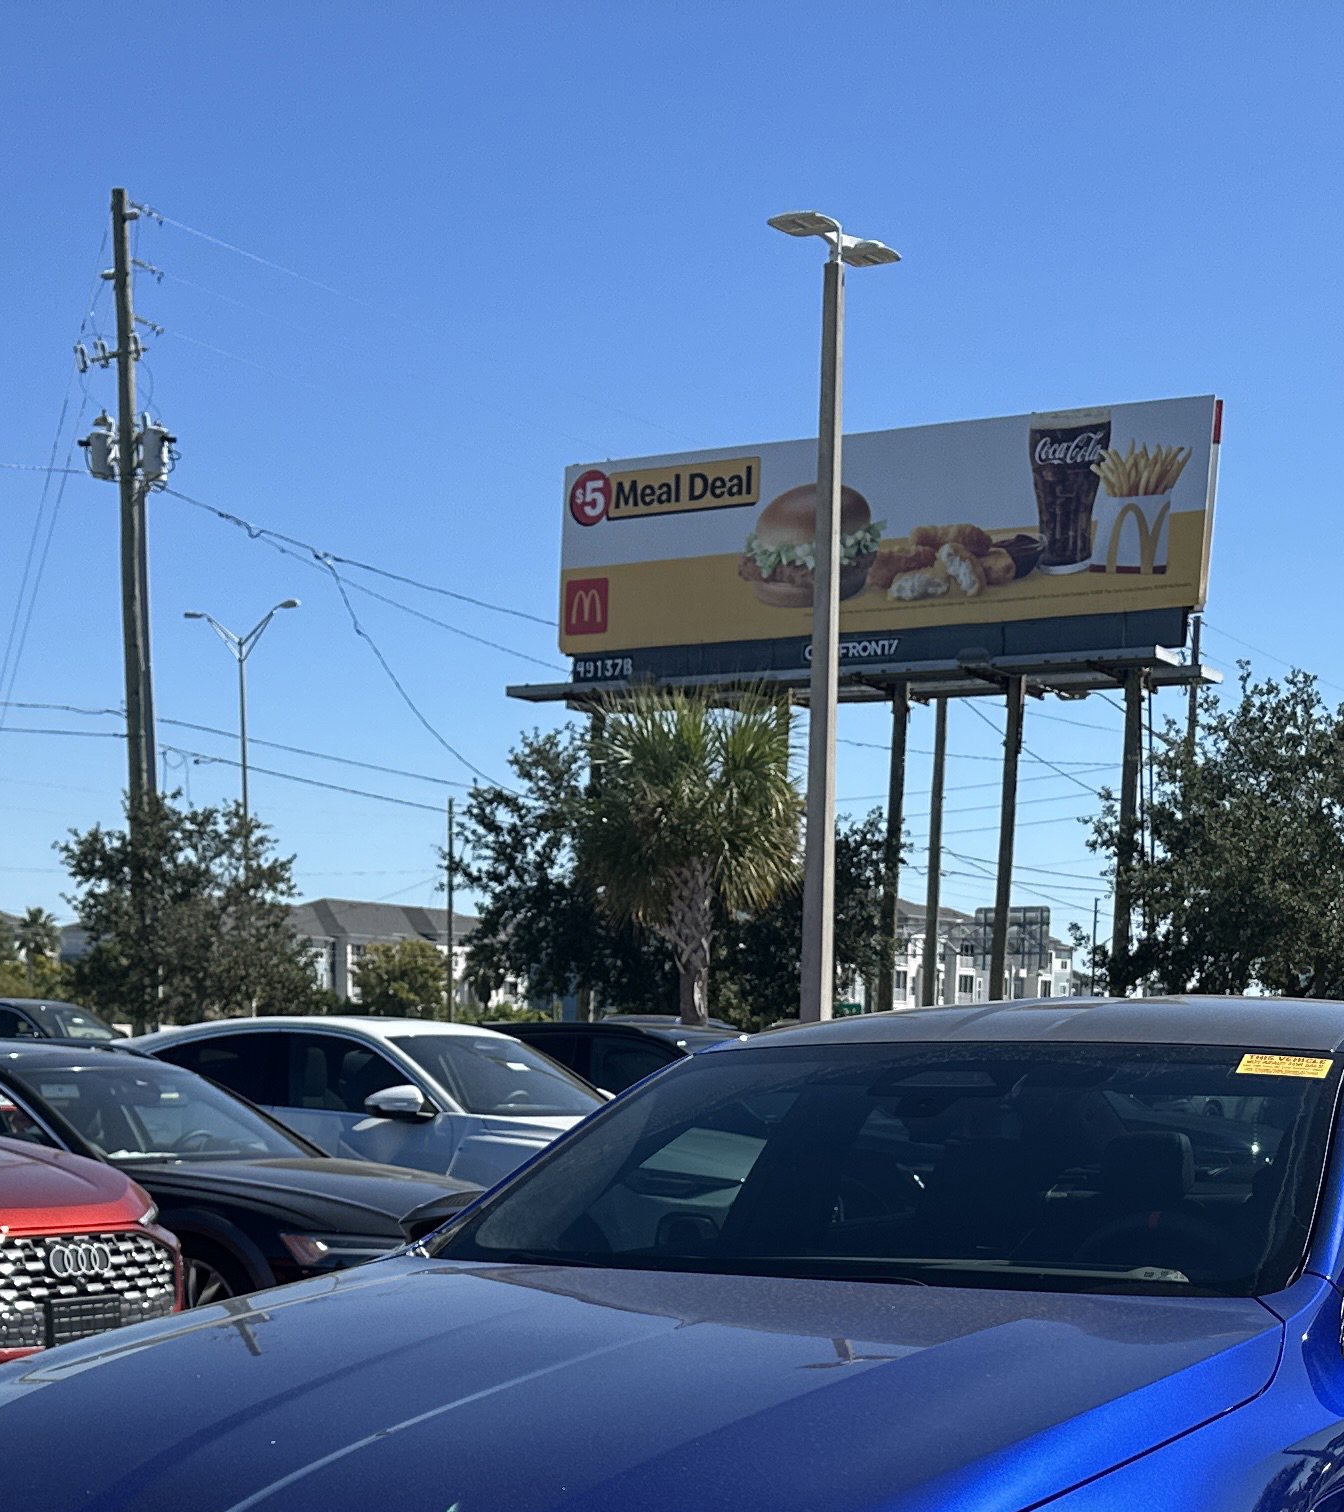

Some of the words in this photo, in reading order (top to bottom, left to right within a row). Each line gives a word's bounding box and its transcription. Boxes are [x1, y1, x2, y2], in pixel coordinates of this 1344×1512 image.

[575, 480, 605, 517] $5
[614, 474, 681, 510] Meal
[689, 465, 753, 501] Deal
